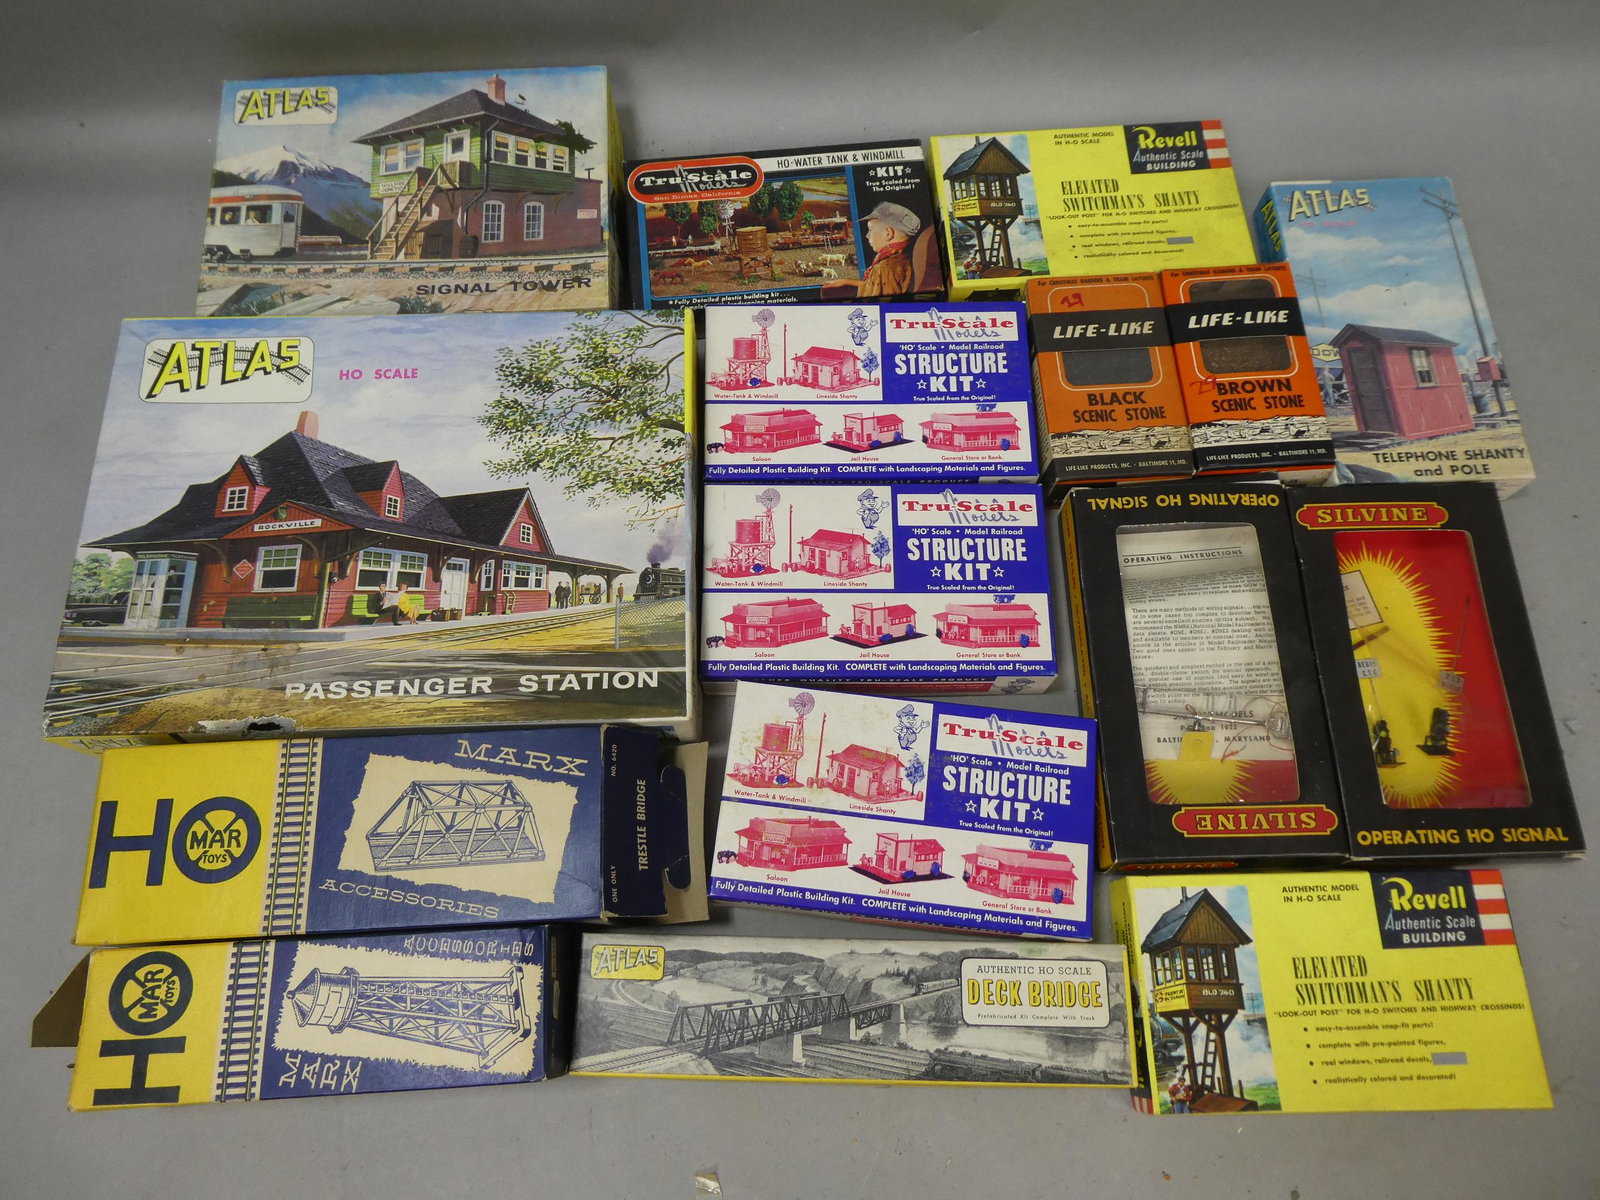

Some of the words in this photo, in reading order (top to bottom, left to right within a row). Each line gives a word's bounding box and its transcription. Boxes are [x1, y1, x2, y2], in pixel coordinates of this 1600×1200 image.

[239, 87, 330, 123] ATLAS
[1132, 126, 1198, 149] Revell
[777, 156, 823, 168] HO-WATER
[826, 154, 849, 164] TANK
[852, 154, 858, 162] &
[862, 150, 905, 161] WINDMILL
[1133, 148, 1178, 163] Authentic
[1181, 149, 1204, 160] Scale
[876, 166, 904, 177] KIT
[1146, 160, 1197, 171] BUILDING
[1061, 178, 1119, 195] ELEVATED
[1063, 194, 1145, 212] SWITCHMAN'S
[1154, 190, 1200, 208] SHANTY
[1288, 188, 1370, 222] ATLAS
[416, 282, 497, 296] SIGNAL
[510, 277, 592, 292] TOWER
[890, 317, 1014, 329] Tru-Scale
[1188, 309, 1289, 329] LIFE-LIKE
[1053, 320, 1155, 339] LIFE-LIKE
[144, 338, 301, 400] ATLAS
[895, 352, 1008, 375] STRUCTURE
[339, 369, 363, 380] HO
[374, 368, 419, 379] SCALE
[930, 376, 974, 392] KIT
[1217, 378, 1292, 396] BROWN
[1087, 391, 1147, 407] BLACK
[1212, 398, 1256, 413] SCENIC
[1265, 394, 1304, 409] STONE
[1073, 409, 1117, 423] SCENIC
[1126, 406, 1166, 421] STONE
[1373, 449, 1460, 464] TELEPHONE
[1464, 447, 1527, 461] SHANTY
[1065, 464, 1089, 472] LIFE-LIKE
[1090, 463, 1119, 471] PRODUCTS,
[1414, 465, 1442, 477] and
[1450, 464, 1490, 476] POLE
[902, 500, 1033, 512] Tru-Scale
[1087, 496, 1148, 511] SIGNAL
[1156, 495, 1182, 507] HO
[1190, 493, 1280, 507] OPERATING
[1317, 506, 1429, 523] SILVINE
[257, 520, 317, 530] ROCKVILLE
[907, 537, 1027, 561] STRUCTURE
[1123, 554, 1172, 564] OPERATING
[1180, 549, 1243, 560] INSTRUCTIONS
[944, 563, 991, 581] KIT
[285, 676, 493, 700] PASSENGER
[519, 671, 659, 692] STATION
[943, 722, 1084, 751] Tru-Scale
[454, 739, 589, 777] MARX
[971, 757, 993, 767] Scale
[1006, 761, 1032, 771] Model
[1035, 765, 1070, 775] Railroad
[942, 765, 1072, 806] STRUCTURE
[636, 779, 646, 821] BRIDGE
[734, 789, 770, 799] Water-Tank
[778, 794, 807, 804] Windmill
[849, 803, 876, 813] Lineside
[876, 806, 896, 815] Shanty
[980, 798, 1030, 822] KIT
[959, 820, 973, 828] True
[974, 822, 995, 831] Scaled
[997, 825, 1012, 833] from
[1013, 826, 1023, 834] the
[1025, 828, 1054, 838] Original!
[1196, 812, 1316, 831] SILVINE
[189, 829, 242, 850] MAR
[1357, 829, 1460, 846] OPERATING
[1466, 829, 1495, 843] HO
[1501, 827, 1568, 842] SIGNAL
[637, 825, 649, 871] TRESTLE
[202, 852, 229, 864] TOYS
[766, 874, 788, 882] Saloon
[878, 888, 890, 896] Jail
[891, 889, 911, 898] House
[1282, 885, 1328, 893] AUTHENTIC
[1331, 884, 1360, 892] MODEL
[1381, 877, 1467, 911] Revell
[319, 879, 500, 919] ACCESSORIES
[716, 881, 736, 891] Fully
[738, 883, 774, 895] Detailed
[776, 888, 803, 899] Plastic
[805, 891, 840, 905] Building
[841, 895, 856, 905] Kit.
[862, 898, 907, 912] COMPLETE
[908, 905, 927, 914] with
[929, 907, 982, 922] Landscaping
[984, 913, 1024, 926] Materials
[1026, 918, 1043, 928] and
[1045, 920, 1078, 932] Figures.
[982, 900, 1008, 909] General
[1010, 902, 1027, 911] Store
[1283, 895, 1293, 903] IN
[1384, 909, 1442, 931] Authentic
[1445, 915, 1476, 929] Scale
[403, 936, 535, 957] ACCESSORIES
[1403, 931, 1467, 944] BUILDING
[594, 947, 659, 976] ATLAS
[977, 965, 1035, 974] AUTHENTIC
[1039, 966, 1055, 975] HO
[1059, 967, 1092, 976] SCALE
[1293, 955, 1368, 980] ELEVATED
[138, 968, 165, 1019] MAR
[161, 978, 180, 1008] TOYS
[967, 978, 1022, 1006] DECK
[1028, 980, 1103, 1008] BRIDGE
[1295, 980, 1402, 1006] SWITCHMAN'S
[1414, 977, 1475, 1002] SHANTY
[1273, 1010, 1317, 1018] "LOOK-OUT
[1480, 1003, 1526, 1011] CROSSINGS!
[279, 1053, 364, 1093] MARX
